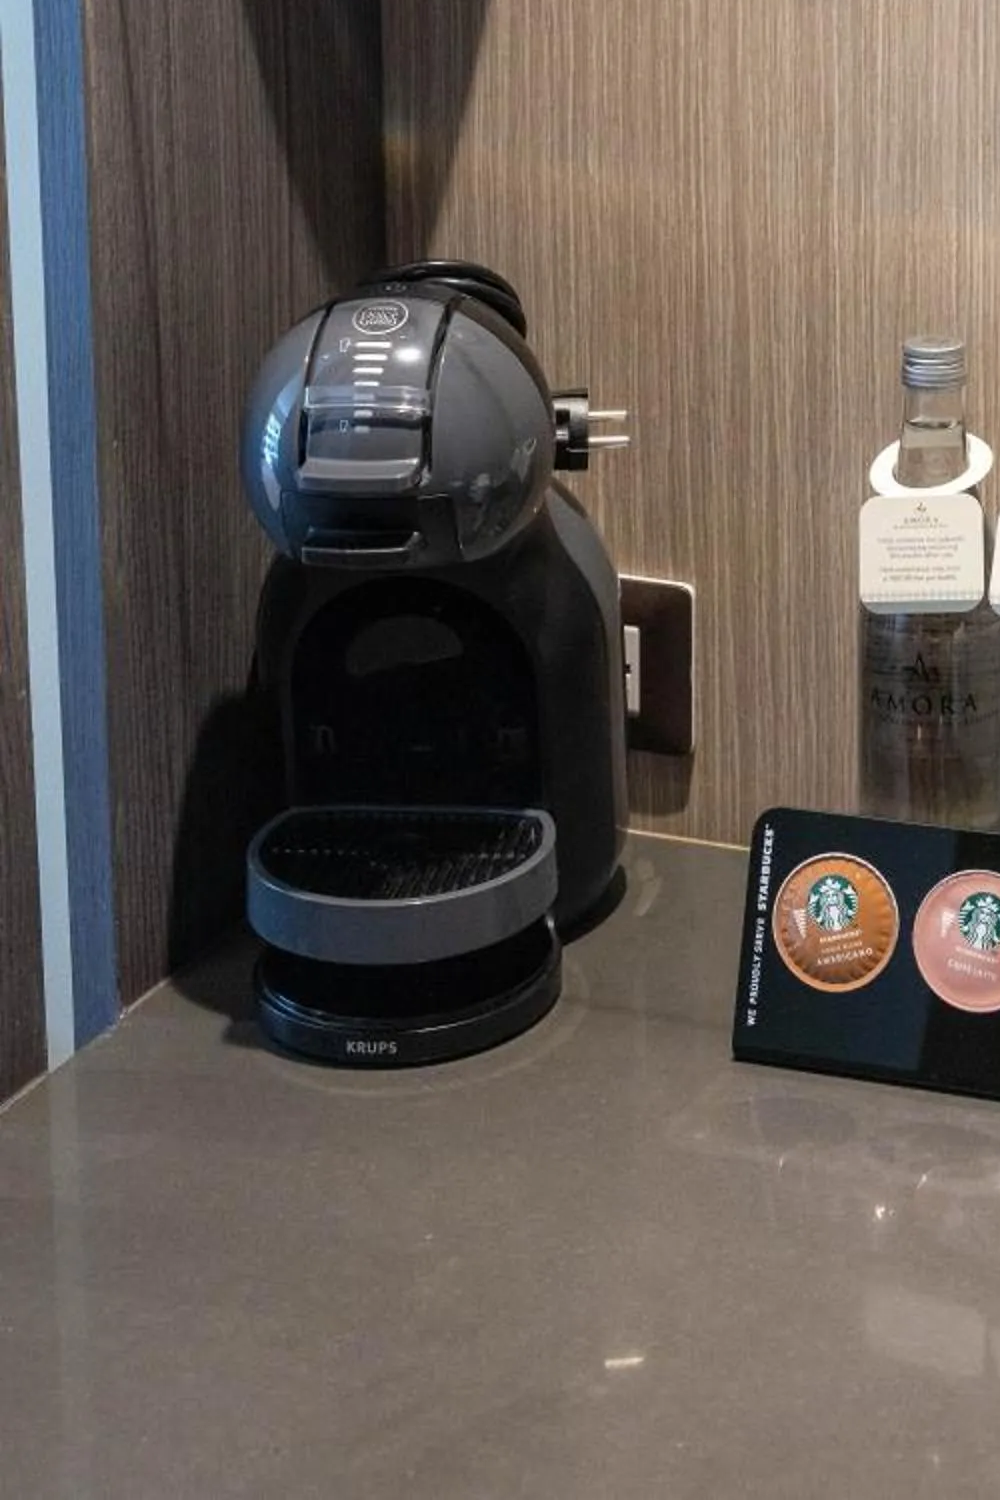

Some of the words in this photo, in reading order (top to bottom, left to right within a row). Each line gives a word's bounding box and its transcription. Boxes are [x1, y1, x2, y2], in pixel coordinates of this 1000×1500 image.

[870, 686, 978, 717] AMORA
[756, 828, 775, 911] STARBUCKS
[753, 917, 766, 953] SERVE
[748, 953, 761, 1006] PROUDLY
[746, 1007, 757, 1027] WE
[346, 1039, 398, 1055] KRUPS
